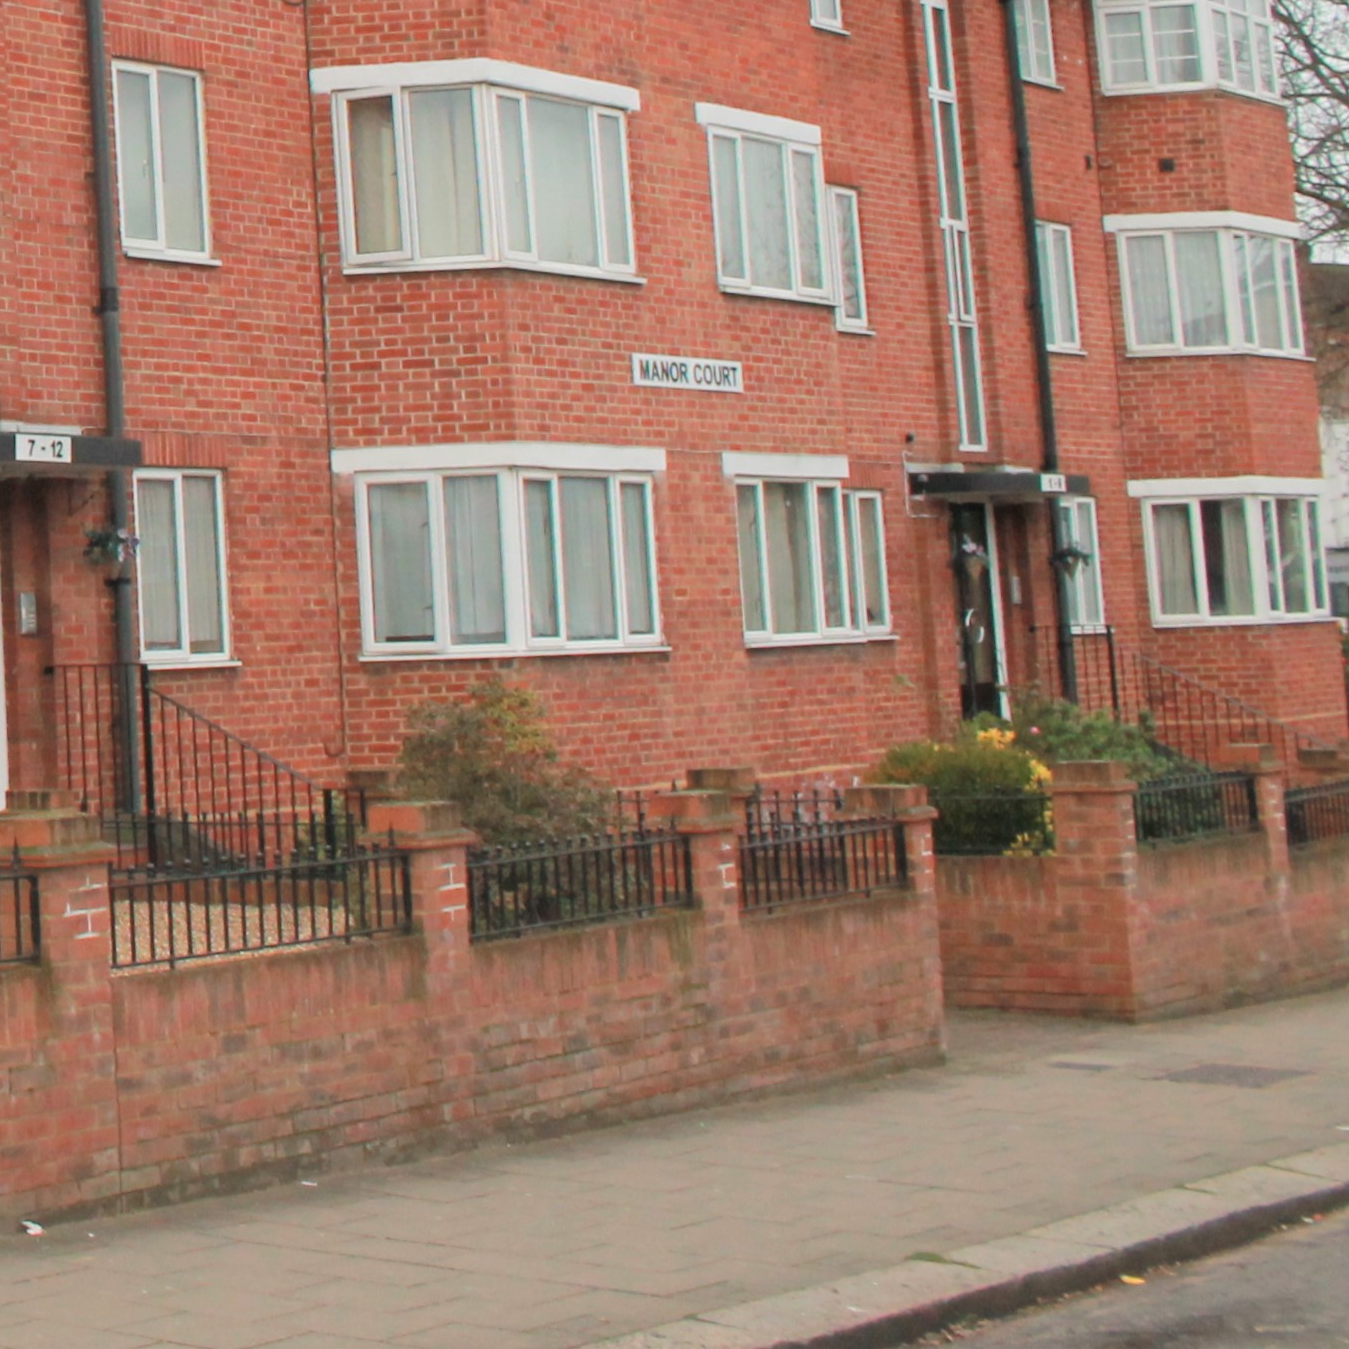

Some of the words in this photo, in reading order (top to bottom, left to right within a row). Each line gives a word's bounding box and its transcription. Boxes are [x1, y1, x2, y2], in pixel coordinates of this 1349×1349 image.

[639, 359, 689, 384] MANOR
[693, 364, 738, 387] COURT
[50, 440, 63, 458] 12
